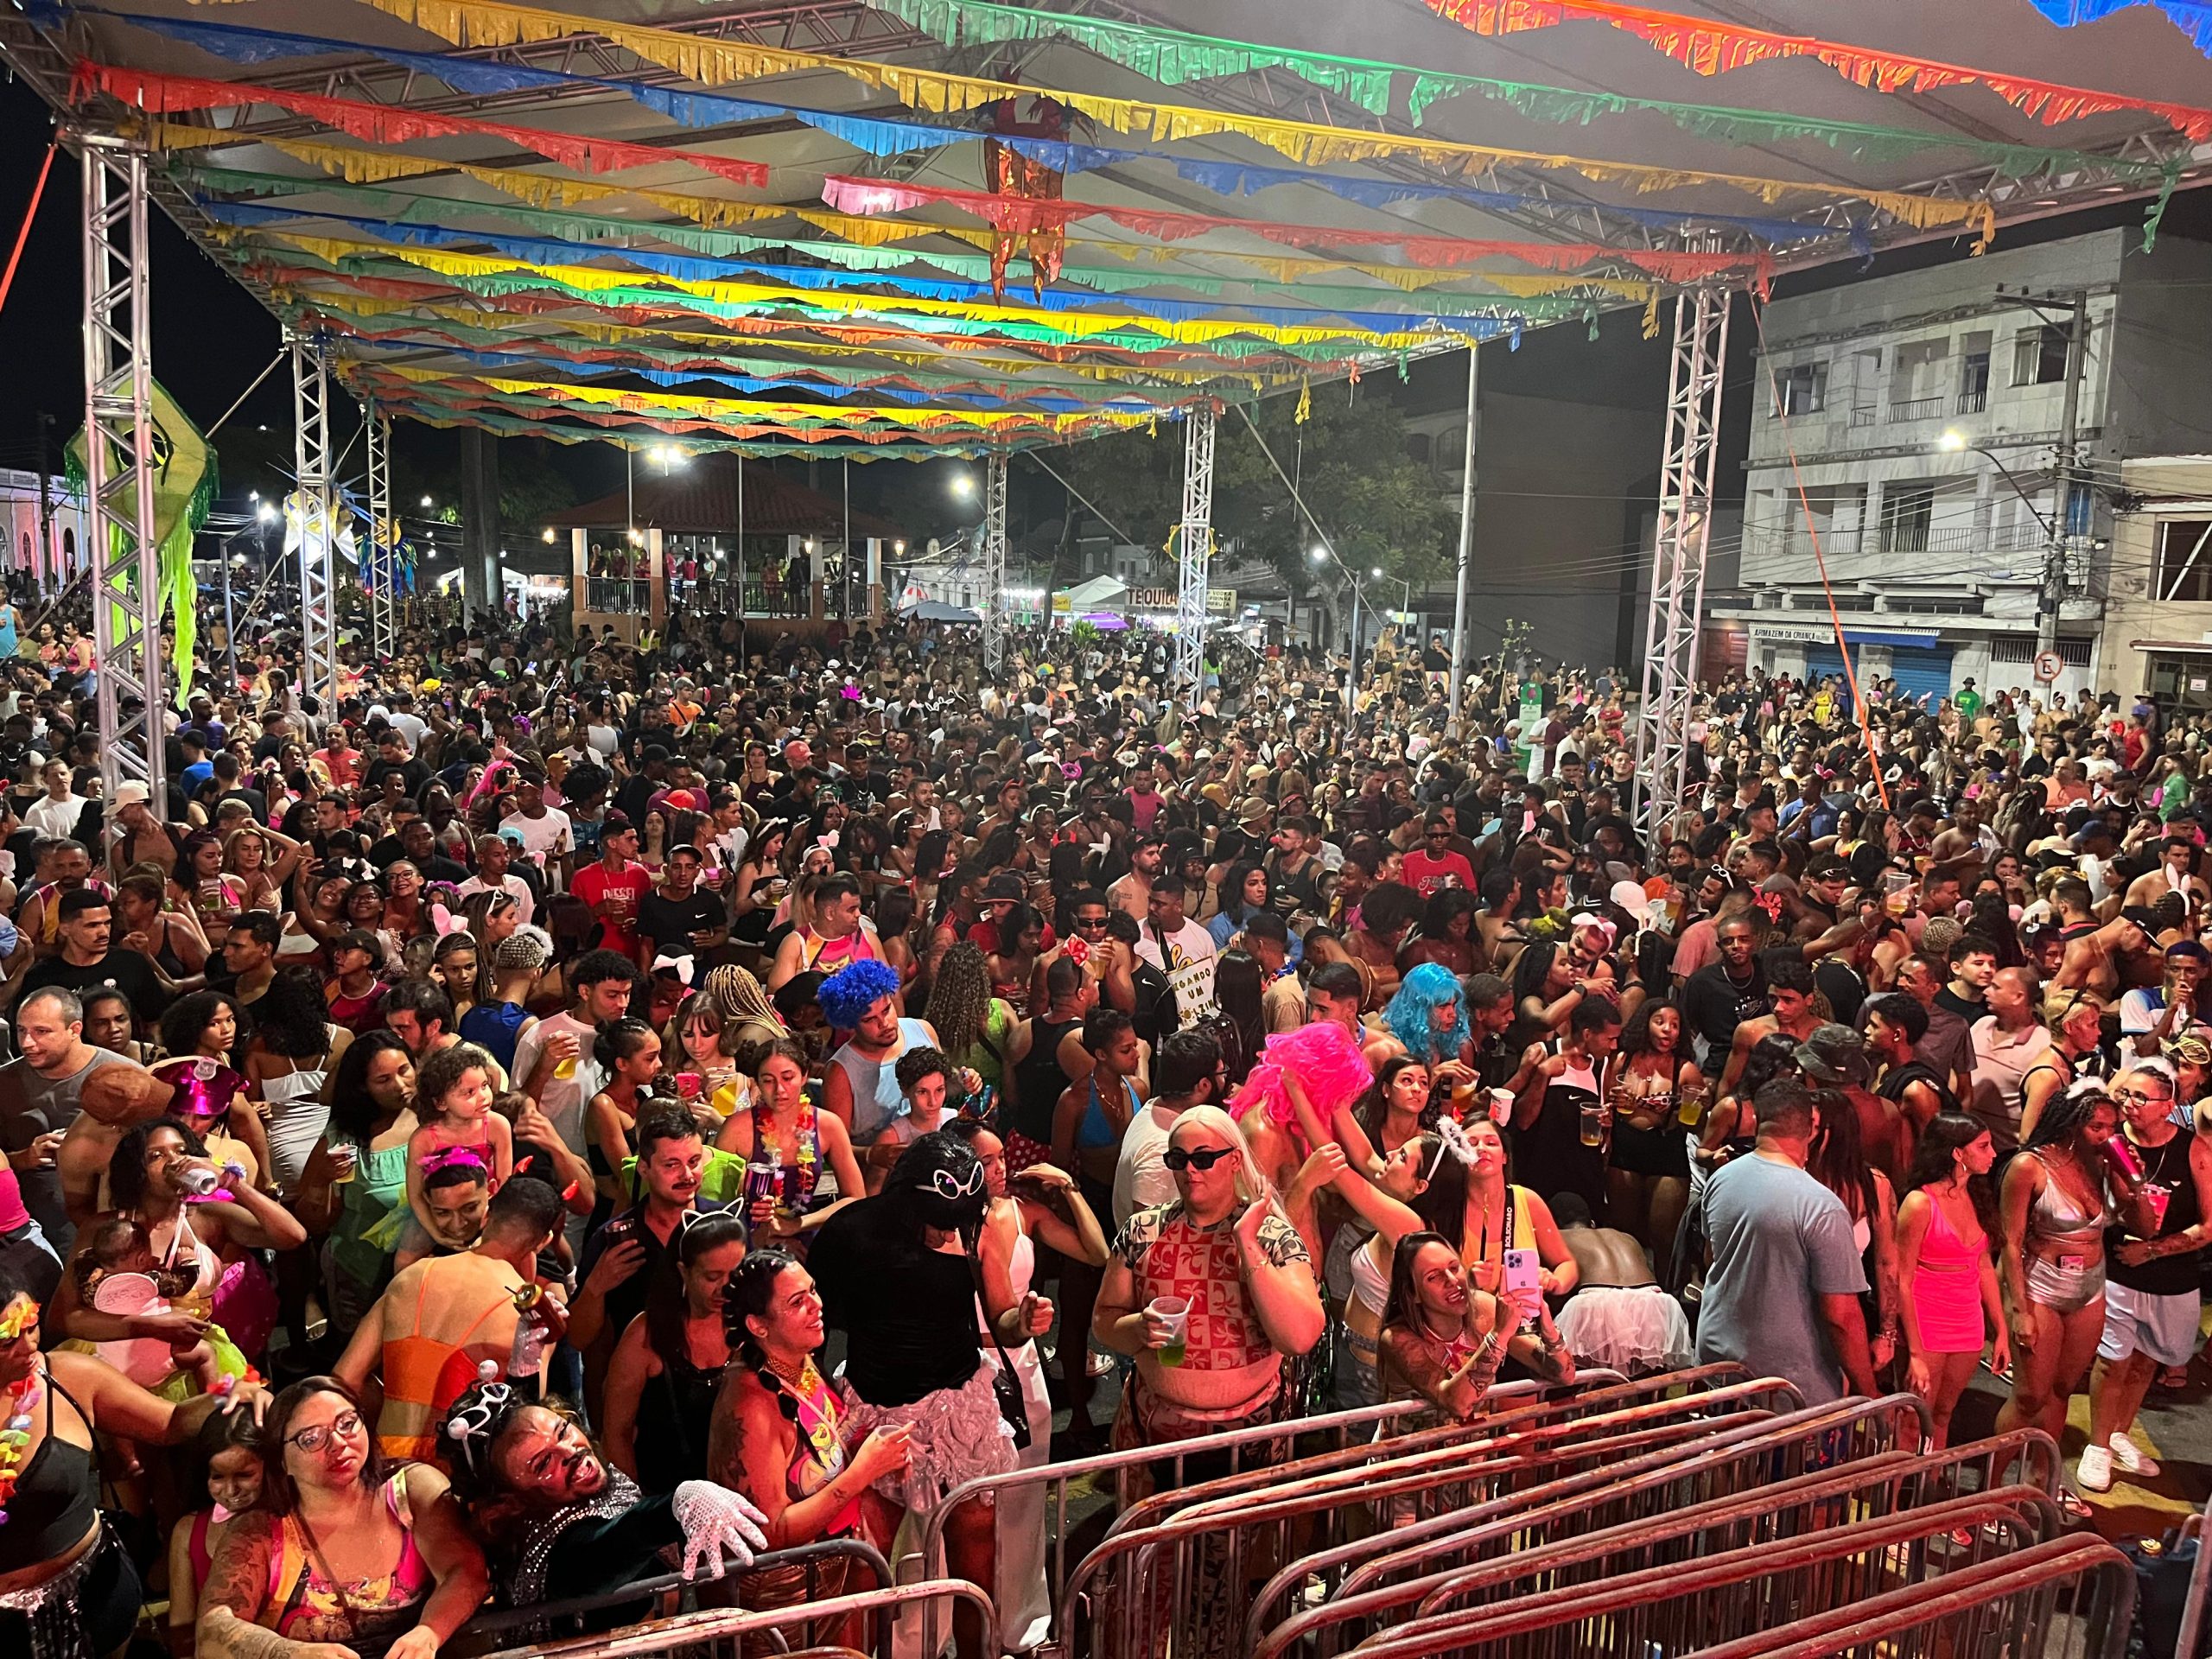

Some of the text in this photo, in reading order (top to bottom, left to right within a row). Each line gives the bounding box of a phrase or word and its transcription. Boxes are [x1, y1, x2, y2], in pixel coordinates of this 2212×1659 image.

[1128, 588, 1178, 605] TEQUILA
[2043, 658, 2052, 674] E
[1187, 986, 1205, 1000] UM
[1504, 1206, 1513, 1248] BOLSONARO
